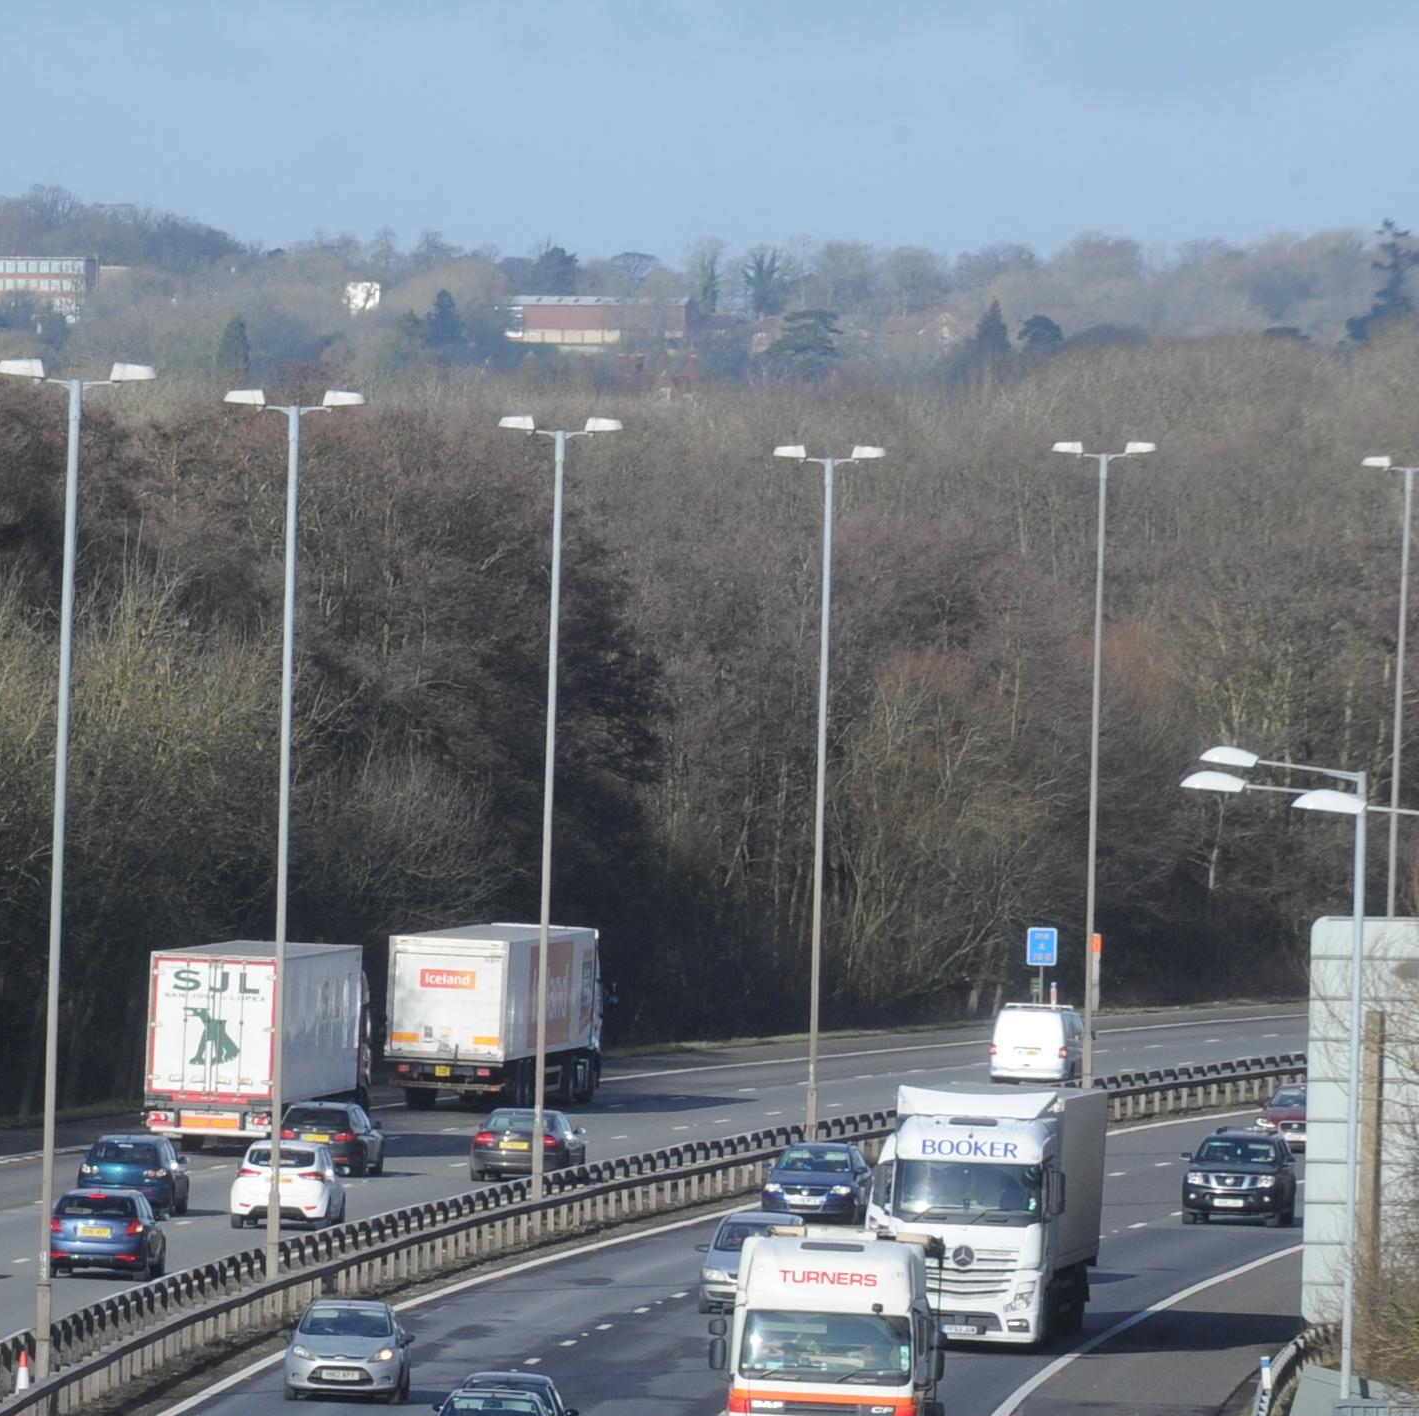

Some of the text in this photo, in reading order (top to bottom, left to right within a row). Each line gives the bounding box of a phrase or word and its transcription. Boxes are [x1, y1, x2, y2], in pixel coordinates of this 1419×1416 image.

[425, 972, 471, 985] Iceland
[921, 1139, 1018, 1159] BOOKER
[779, 1269, 878, 1287] TURNERS
[871, 1406, 894, 1414] CF
